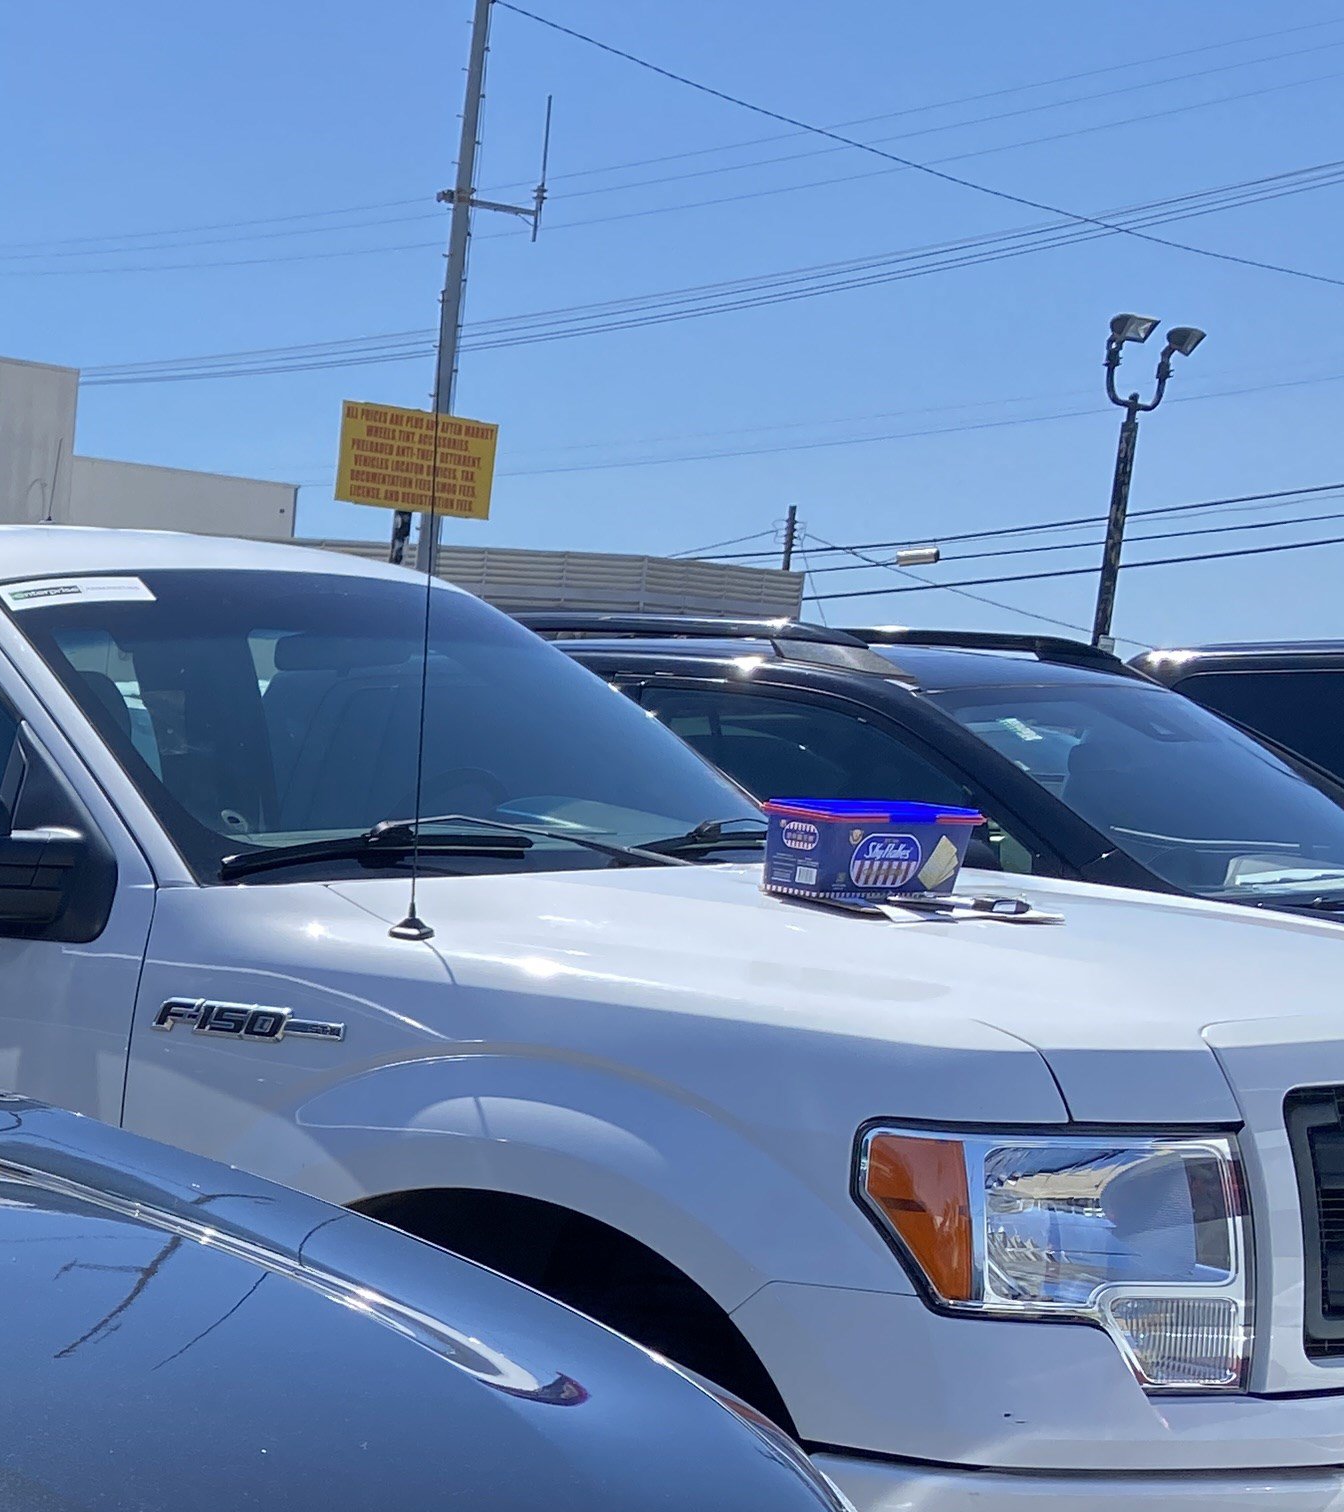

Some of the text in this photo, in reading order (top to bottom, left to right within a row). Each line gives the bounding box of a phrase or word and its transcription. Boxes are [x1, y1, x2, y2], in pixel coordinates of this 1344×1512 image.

[346, 406, 495, 440] ALL PRICES ARE PLUS AN AFTER MARKET
[353, 454, 389, 470] VEHICLES
[390, 460, 425, 475] LOCATOR
[350, 469, 414, 489] DOCUMENTATION
[436, 481, 457, 496] SMOG
[384, 489, 400, 502] AND
[12, 586, 80, 600] enterprise
[151, 997, 294, 1044] F-150
